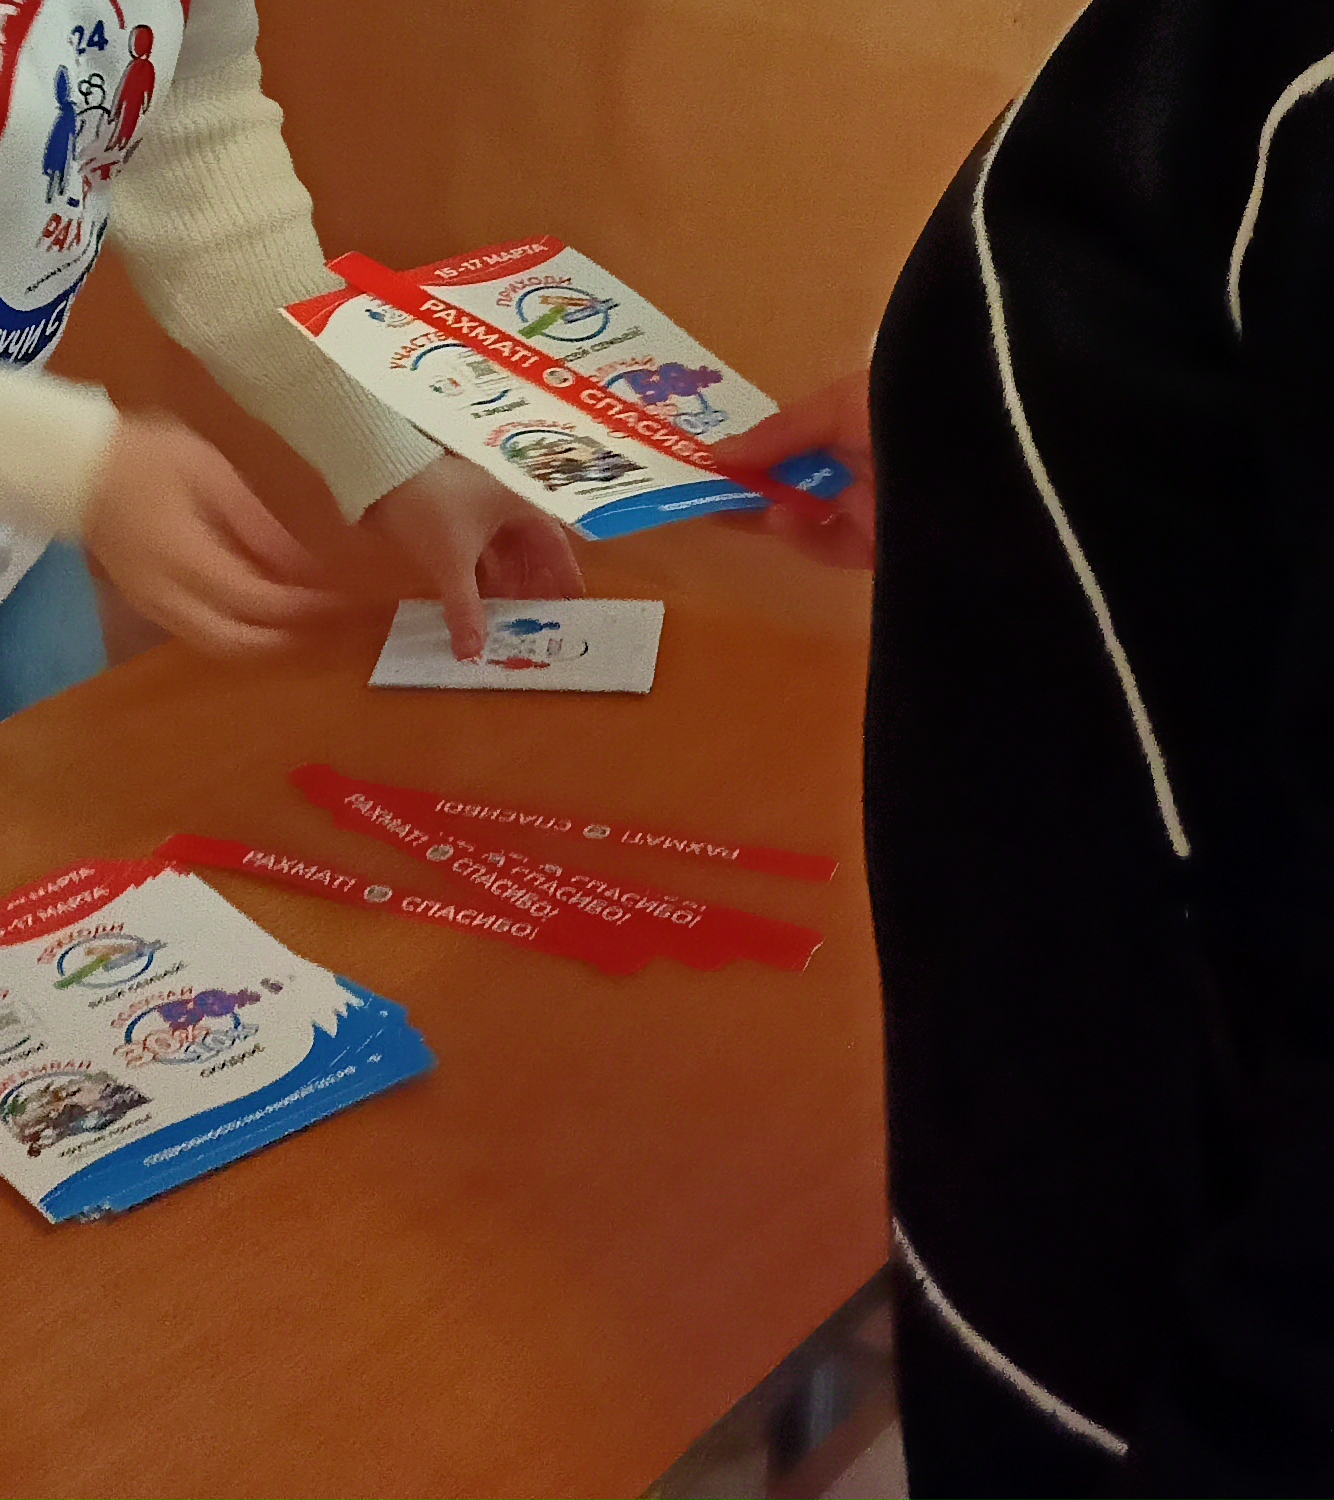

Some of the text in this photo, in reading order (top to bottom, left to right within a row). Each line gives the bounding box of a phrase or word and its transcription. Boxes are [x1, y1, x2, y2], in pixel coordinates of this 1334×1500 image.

[433, 242, 550, 281] 15-17 МАРТА
[419, 298, 541, 369] РАХМАТ!
[243, 850, 540, 942] РАХМАТ! СПАСИБО!
[451, 856, 560, 922] СПАСИБО!
